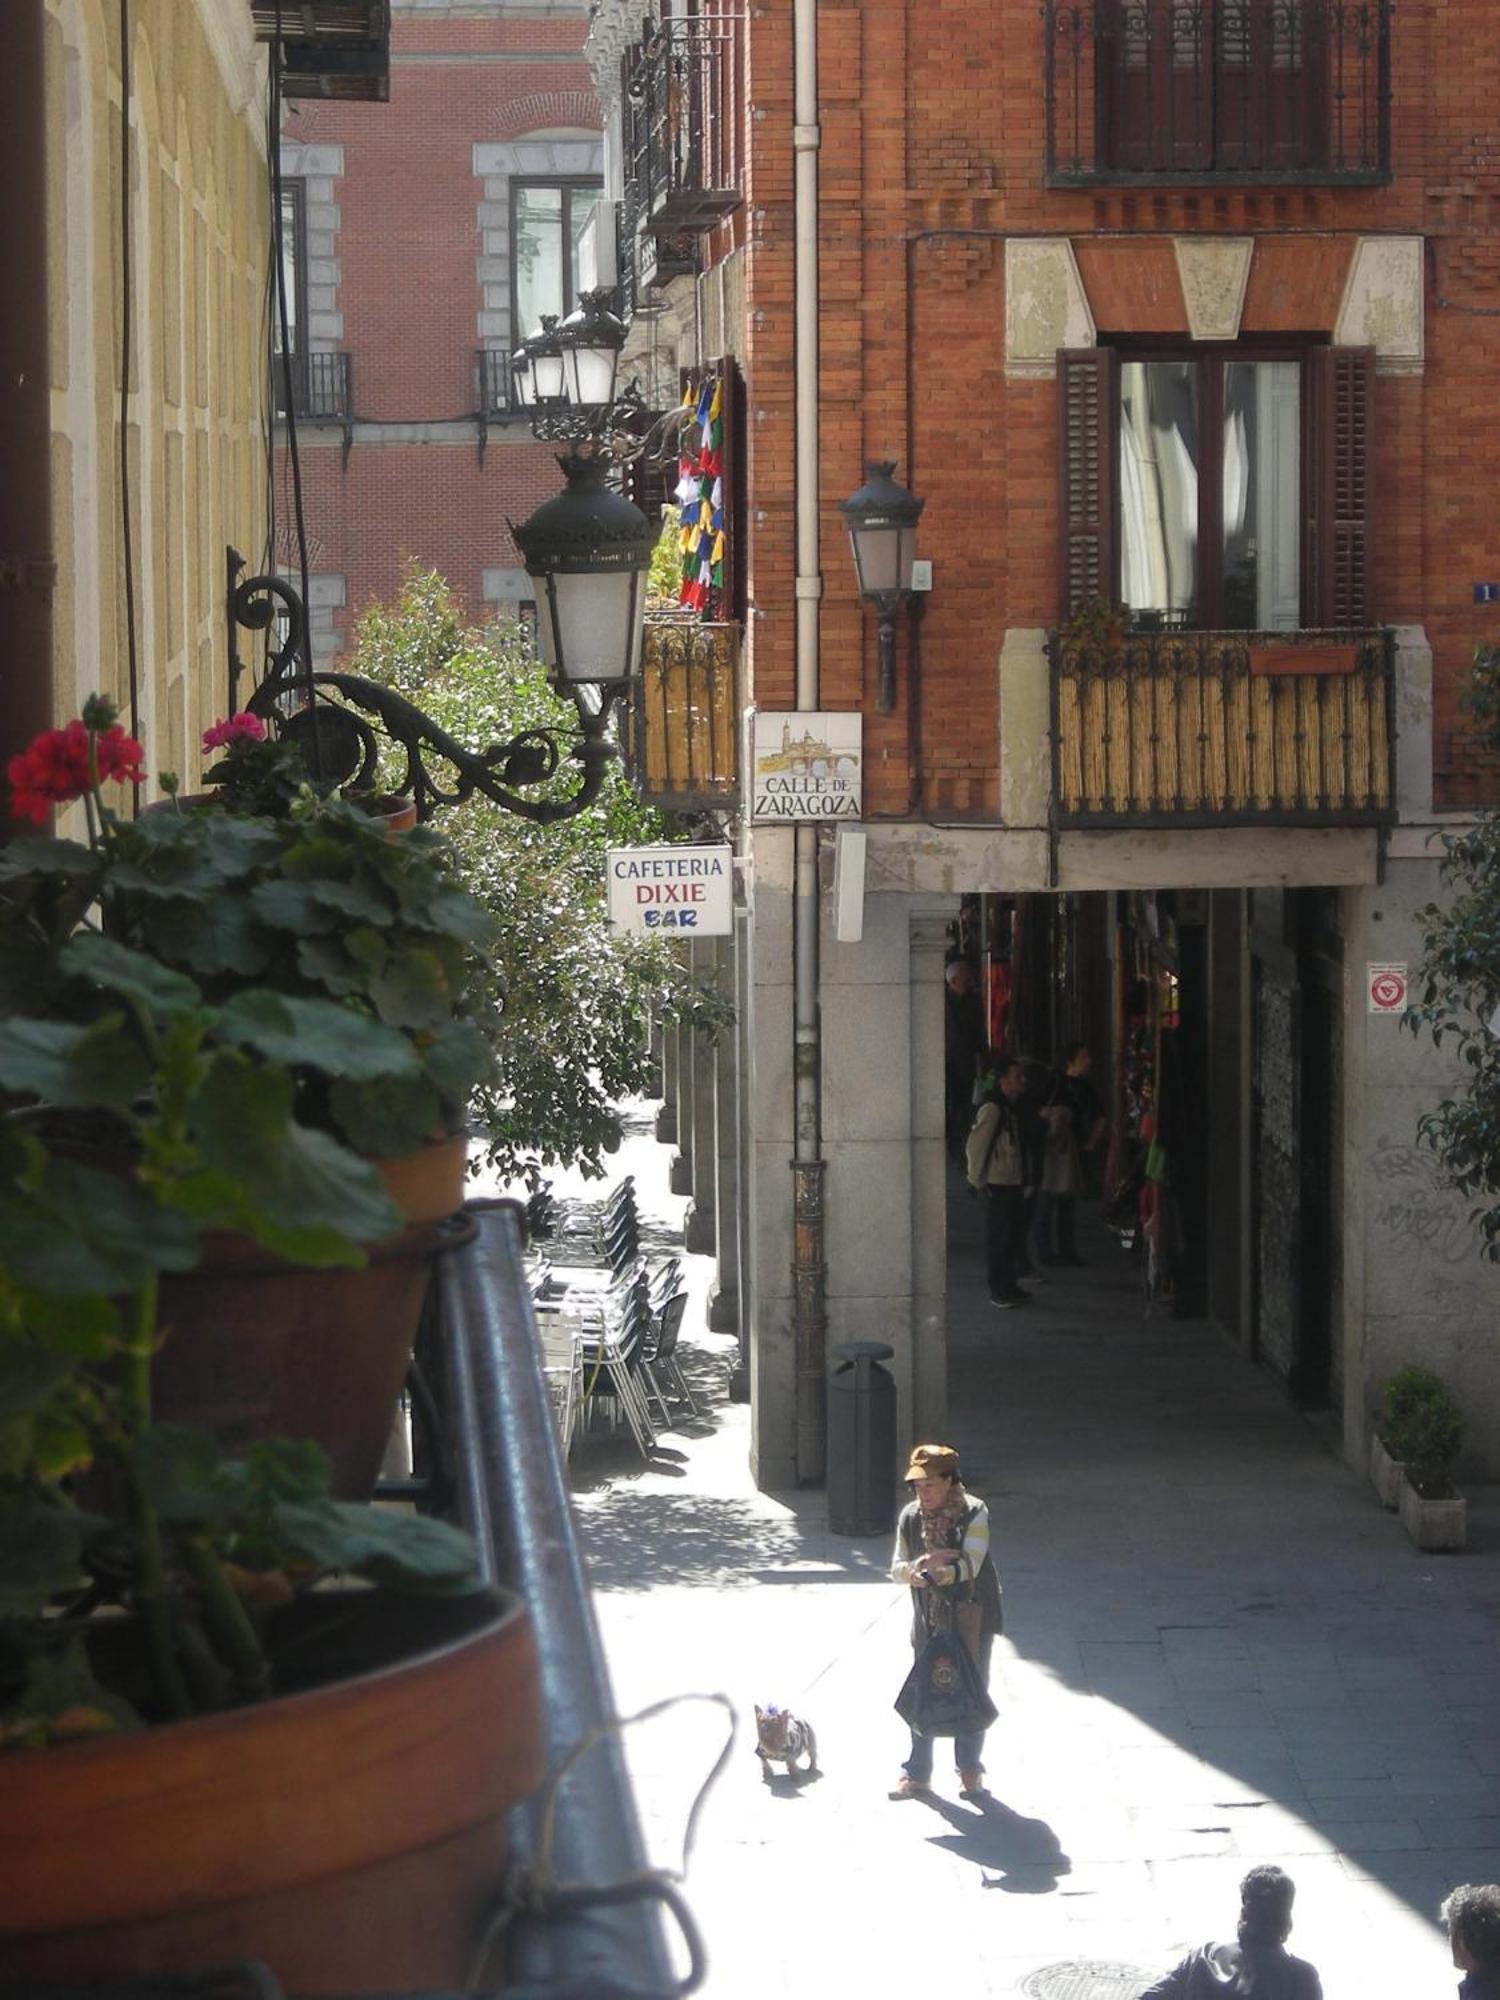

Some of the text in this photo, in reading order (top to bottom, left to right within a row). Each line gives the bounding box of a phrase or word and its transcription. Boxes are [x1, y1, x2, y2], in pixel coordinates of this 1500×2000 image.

[1483, 583, 1491, 601] 1
[766, 777, 851, 794] CALLE DE
[755, 795, 860, 816] ZARAGOZA
[615, 858, 723, 879] CAFETERIA
[636, 883, 706, 904] DIXIE
[644, 910, 698, 928] BAR
